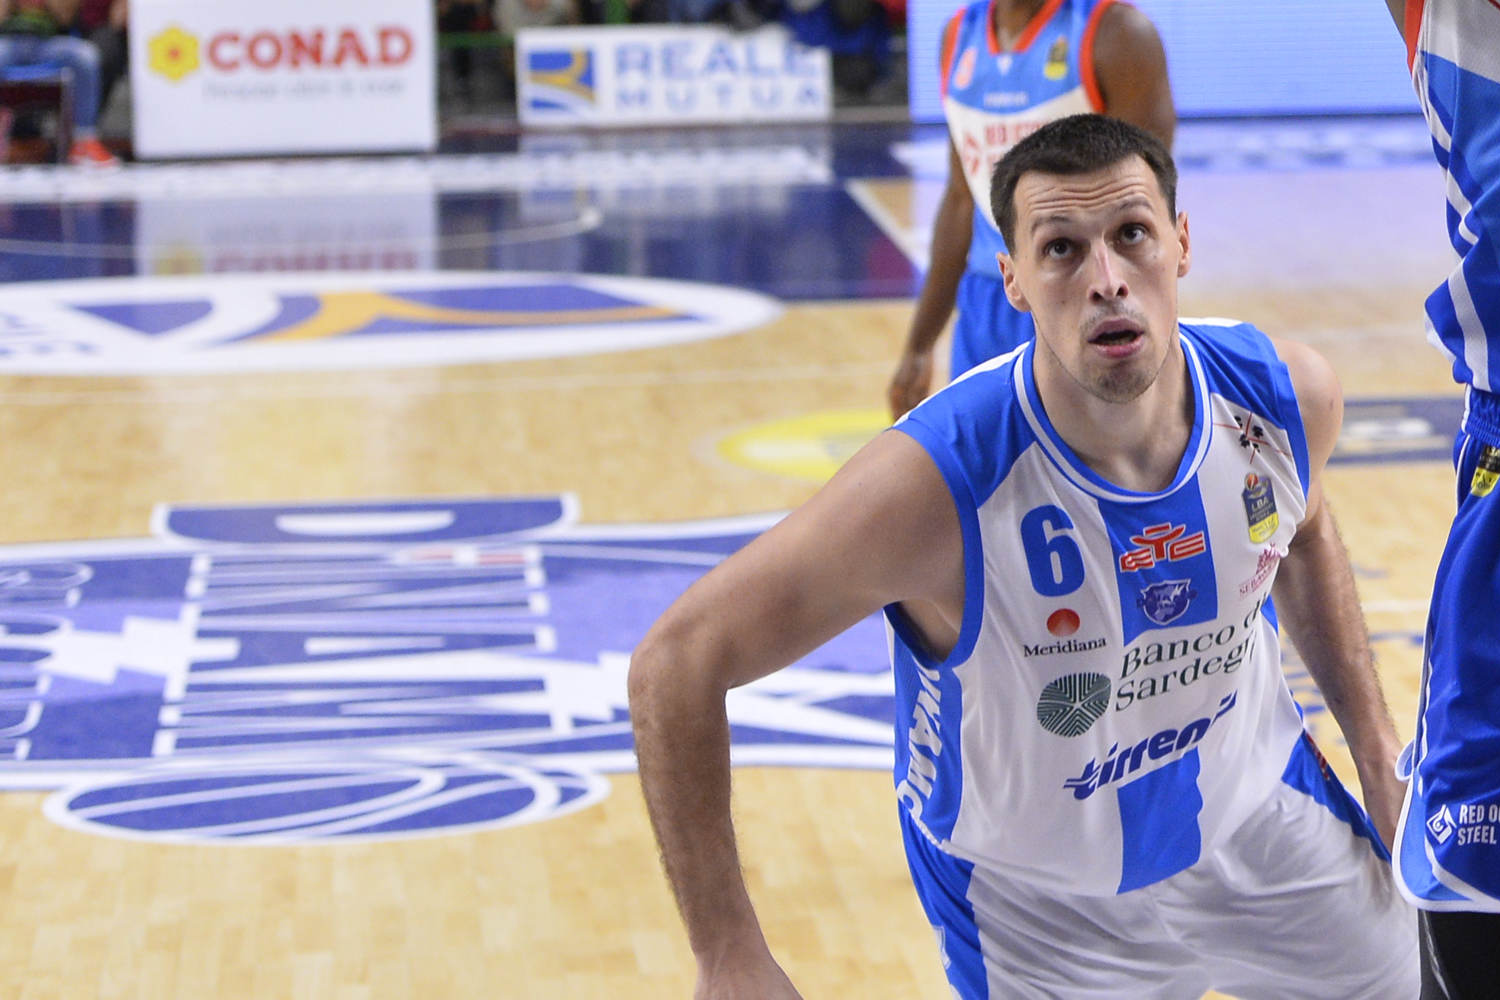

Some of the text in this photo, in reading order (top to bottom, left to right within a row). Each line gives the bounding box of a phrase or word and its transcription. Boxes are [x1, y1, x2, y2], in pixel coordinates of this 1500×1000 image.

[207, 26, 416, 73] CONAD
[1020, 504, 1086, 598] 6
[1024, 638, 1107, 658] Meridiana
[1120, 624, 1236, 680] Banco
[1459, 804, 1485, 824] RED
[1457, 825, 1497, 845] STEEL
